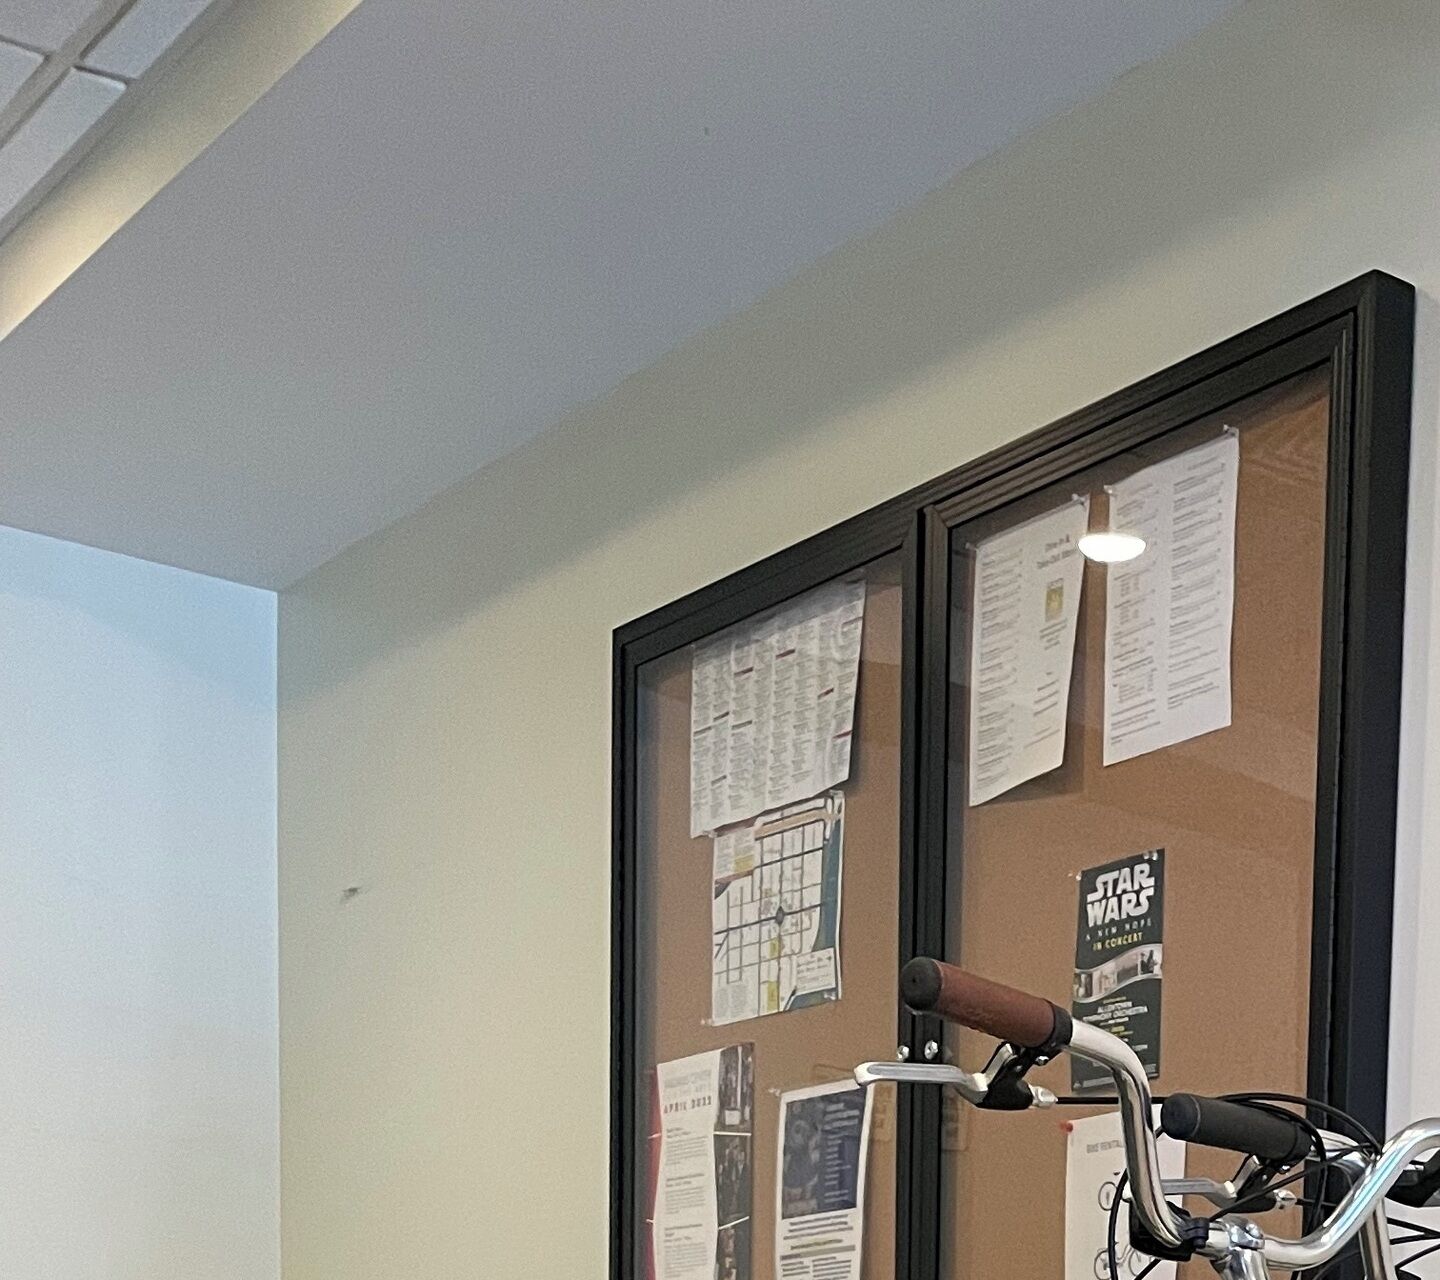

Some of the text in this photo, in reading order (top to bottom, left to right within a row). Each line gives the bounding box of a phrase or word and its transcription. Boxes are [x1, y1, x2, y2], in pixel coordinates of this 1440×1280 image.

[1086, 863, 1155, 903] STAR
[1086, 887, 1154, 928] WARS
[1105, 932, 1143, 949] CONCERT
